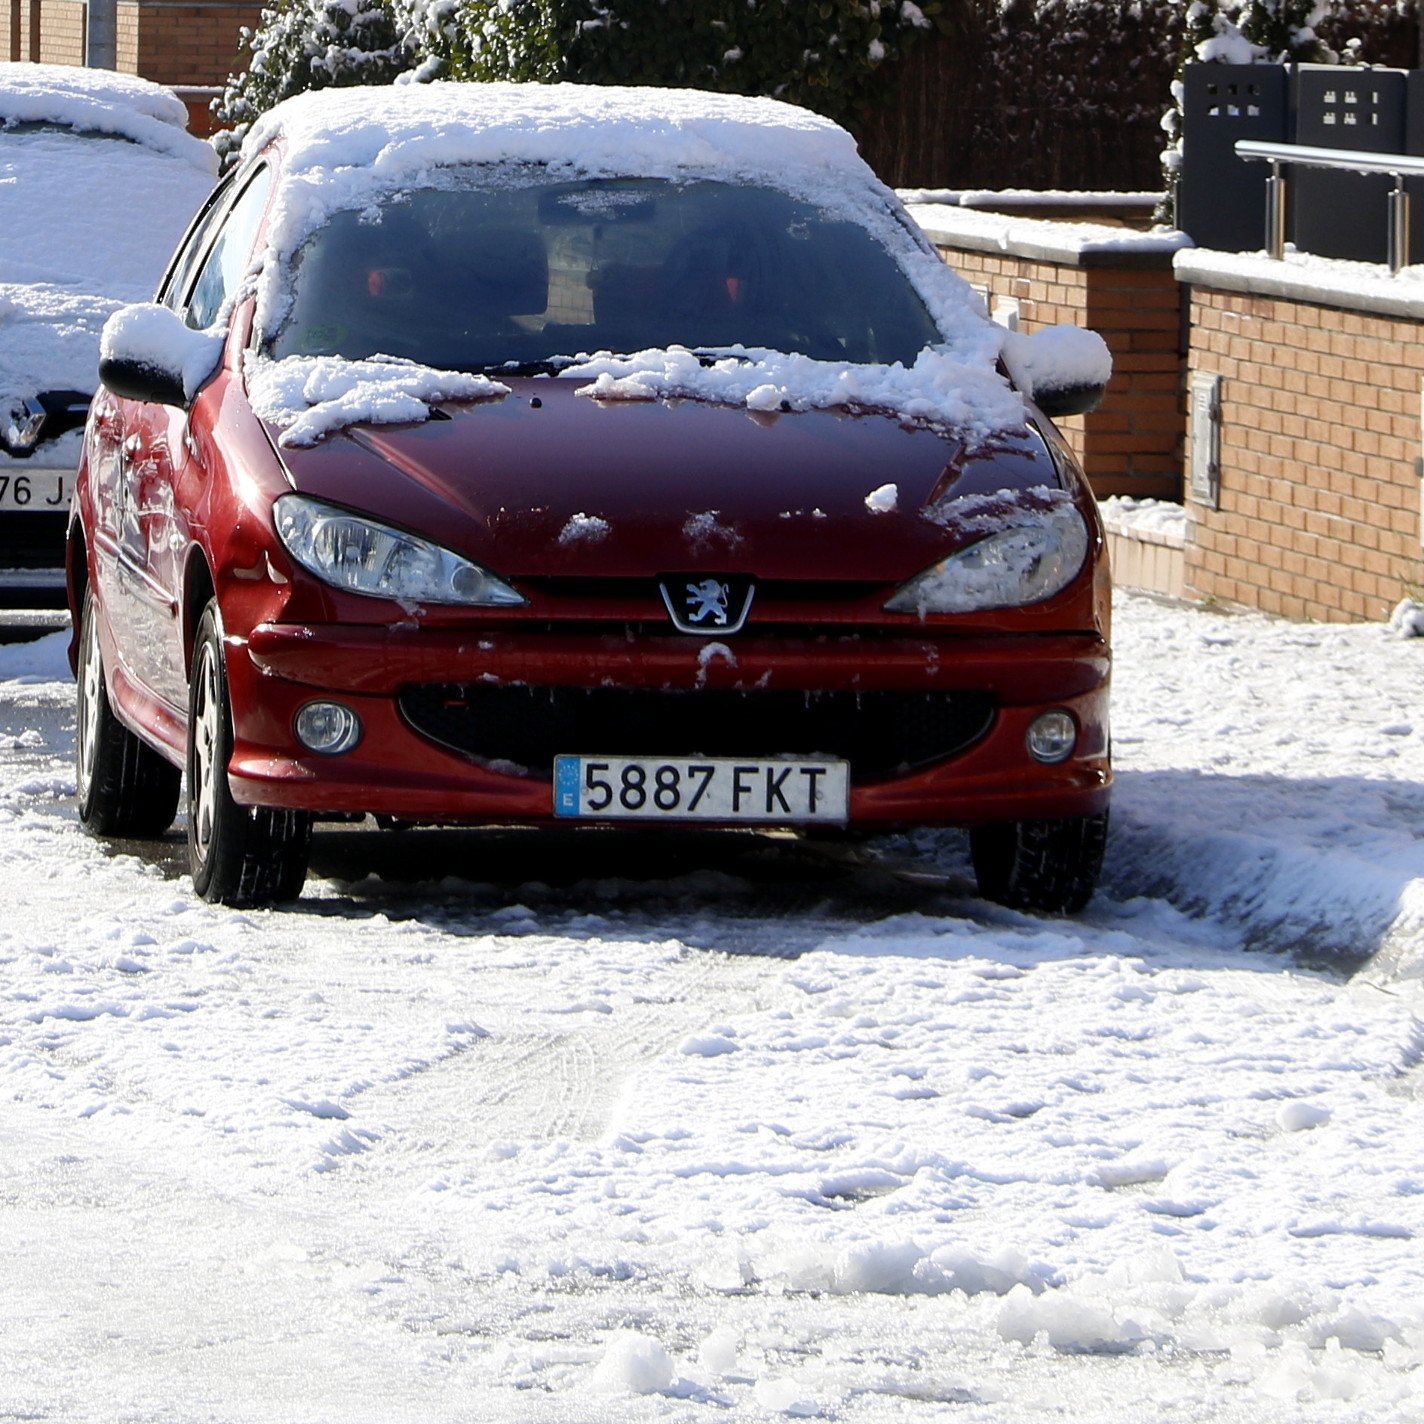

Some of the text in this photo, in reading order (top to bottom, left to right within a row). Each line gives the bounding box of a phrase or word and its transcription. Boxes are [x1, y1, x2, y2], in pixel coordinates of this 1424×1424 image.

[562, 792, 574, 807] E
[585, 762, 827, 814] 5887 FKT
